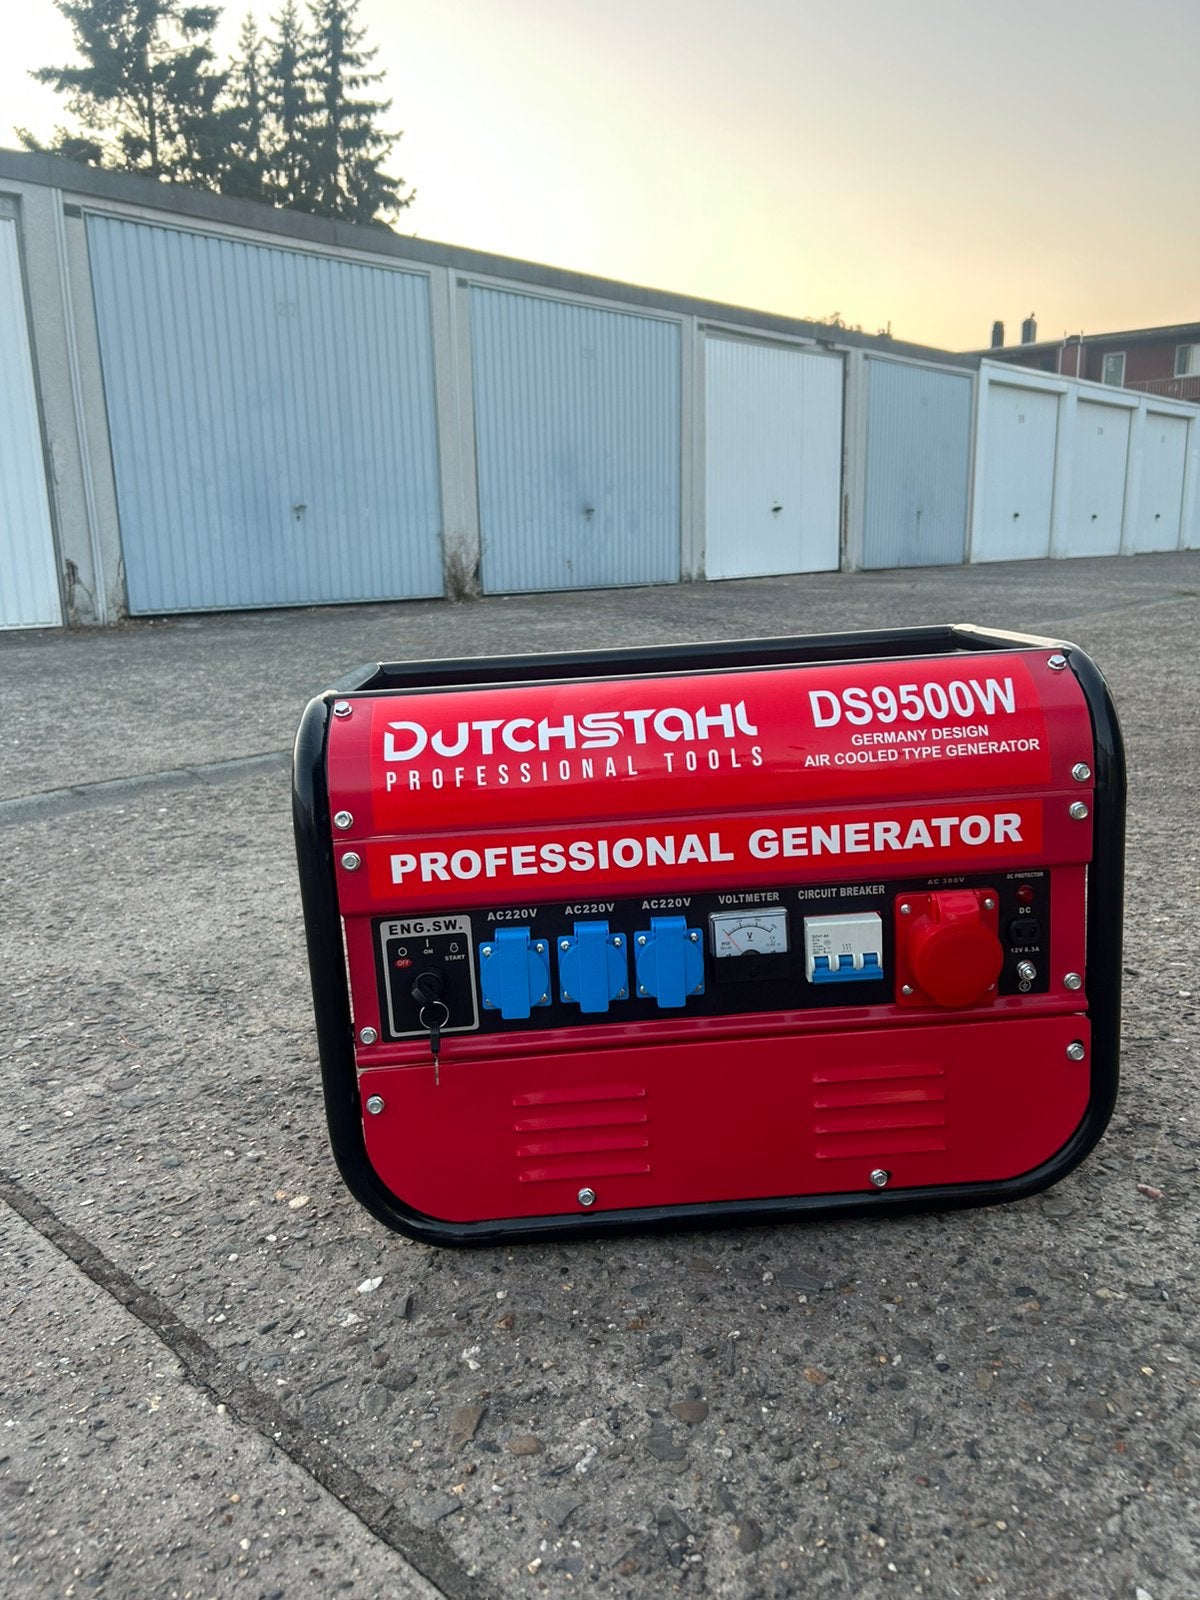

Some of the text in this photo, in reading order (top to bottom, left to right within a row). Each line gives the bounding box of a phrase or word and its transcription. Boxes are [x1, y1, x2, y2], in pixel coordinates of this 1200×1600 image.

[808, 677, 1016, 728] DS9500W
[851, 725, 989, 746] GERMANY DESIGN
[804, 739, 1040, 767] AIR COOLED TYPE GENERATOR
[386, 746, 763, 792] PROFESSIONAL TOOLS
[390, 813, 1022, 884] PROFESSIONAL GENERATOR
[942, 876, 965, 885] 380V
[718, 891, 780, 905] VOLTMETER
[798, 885, 886, 900] CIRCUIT BREAKER
[565, 902, 615, 915] AC220V
[641, 897, 691, 910] AC220V
[1019, 906, 1031, 914] DC
[487, 908, 537, 921] AC220V
[388, 919, 463, 936] ENG.SW.
[747, 932, 753, 940] V
[396, 958, 410, 967] OFF
[444, 953, 466, 961] START
